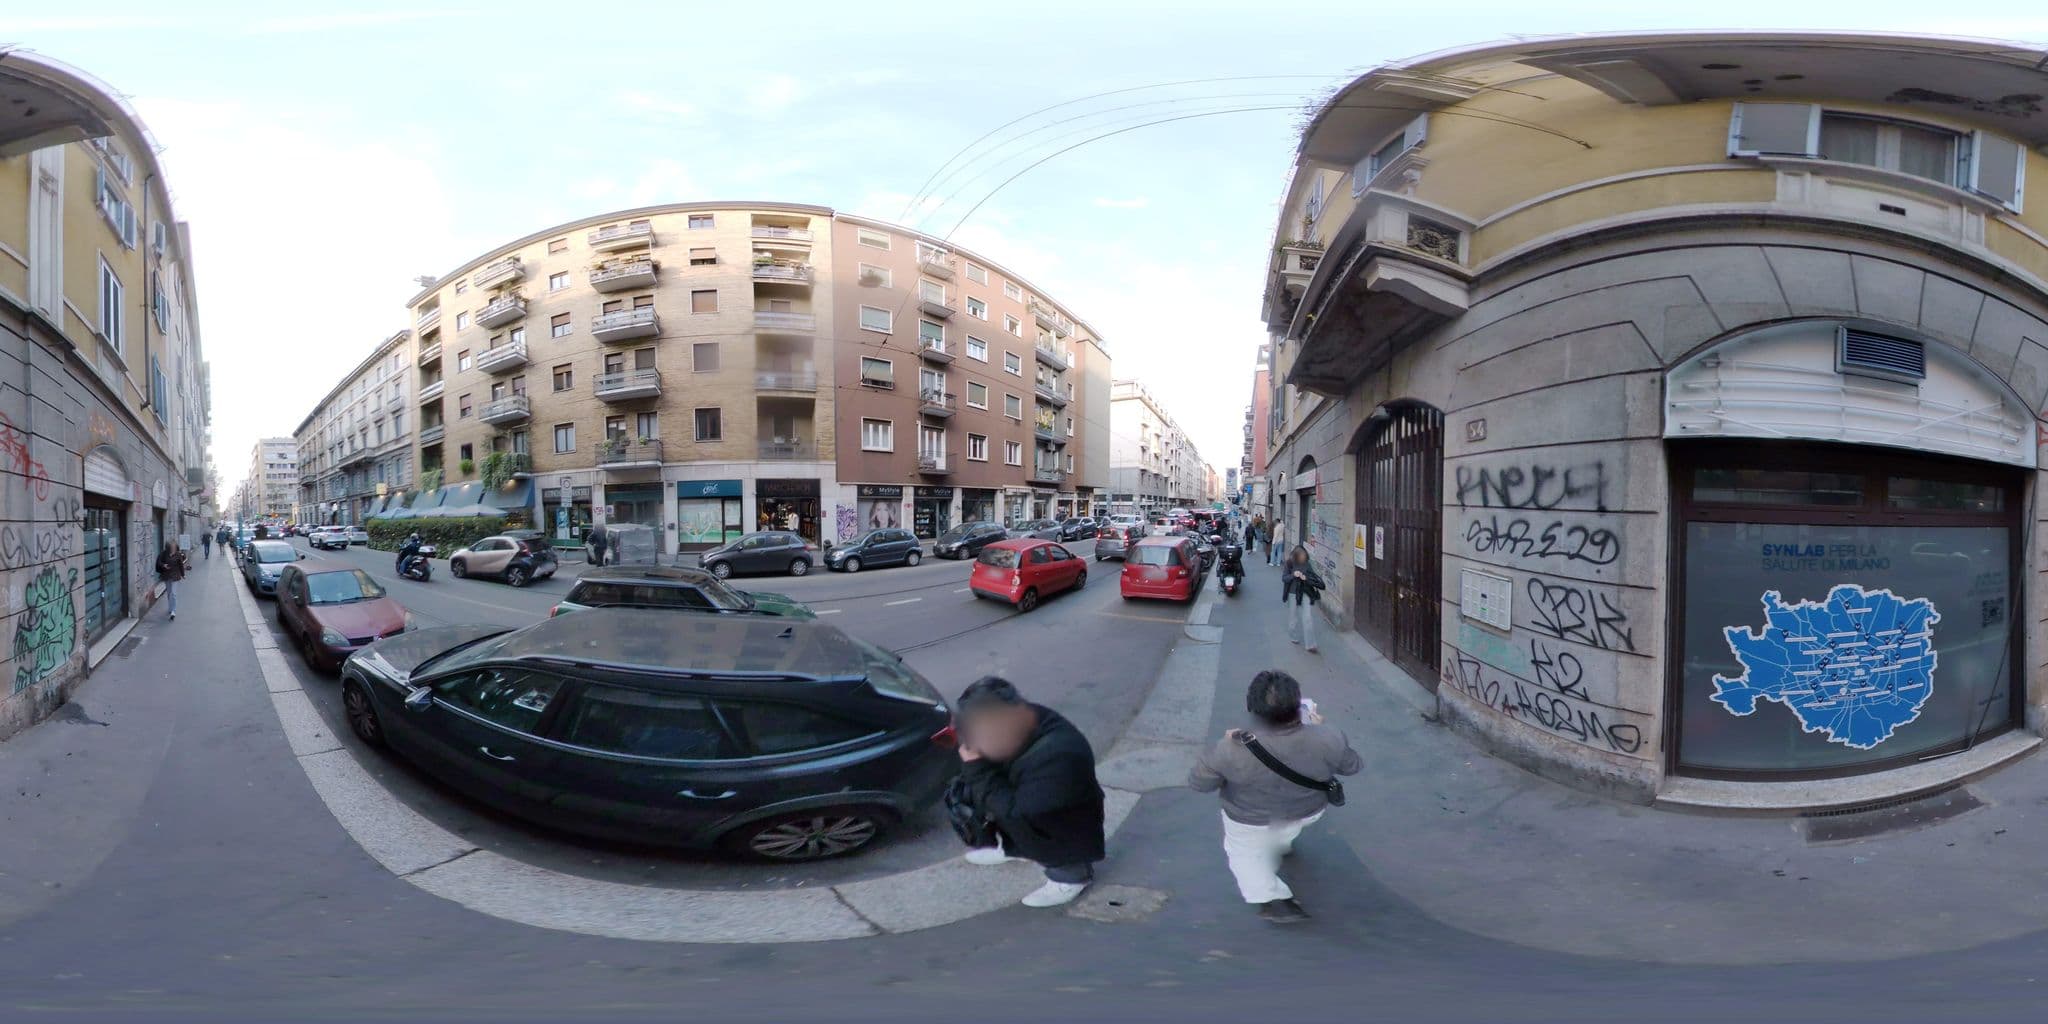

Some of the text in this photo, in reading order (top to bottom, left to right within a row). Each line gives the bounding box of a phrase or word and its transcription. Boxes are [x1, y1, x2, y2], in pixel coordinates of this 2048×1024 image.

[1762, 543, 1877, 557] SYNLAB PER LA
[1761, 558, 1891, 571] SALUTE DI MILANO
